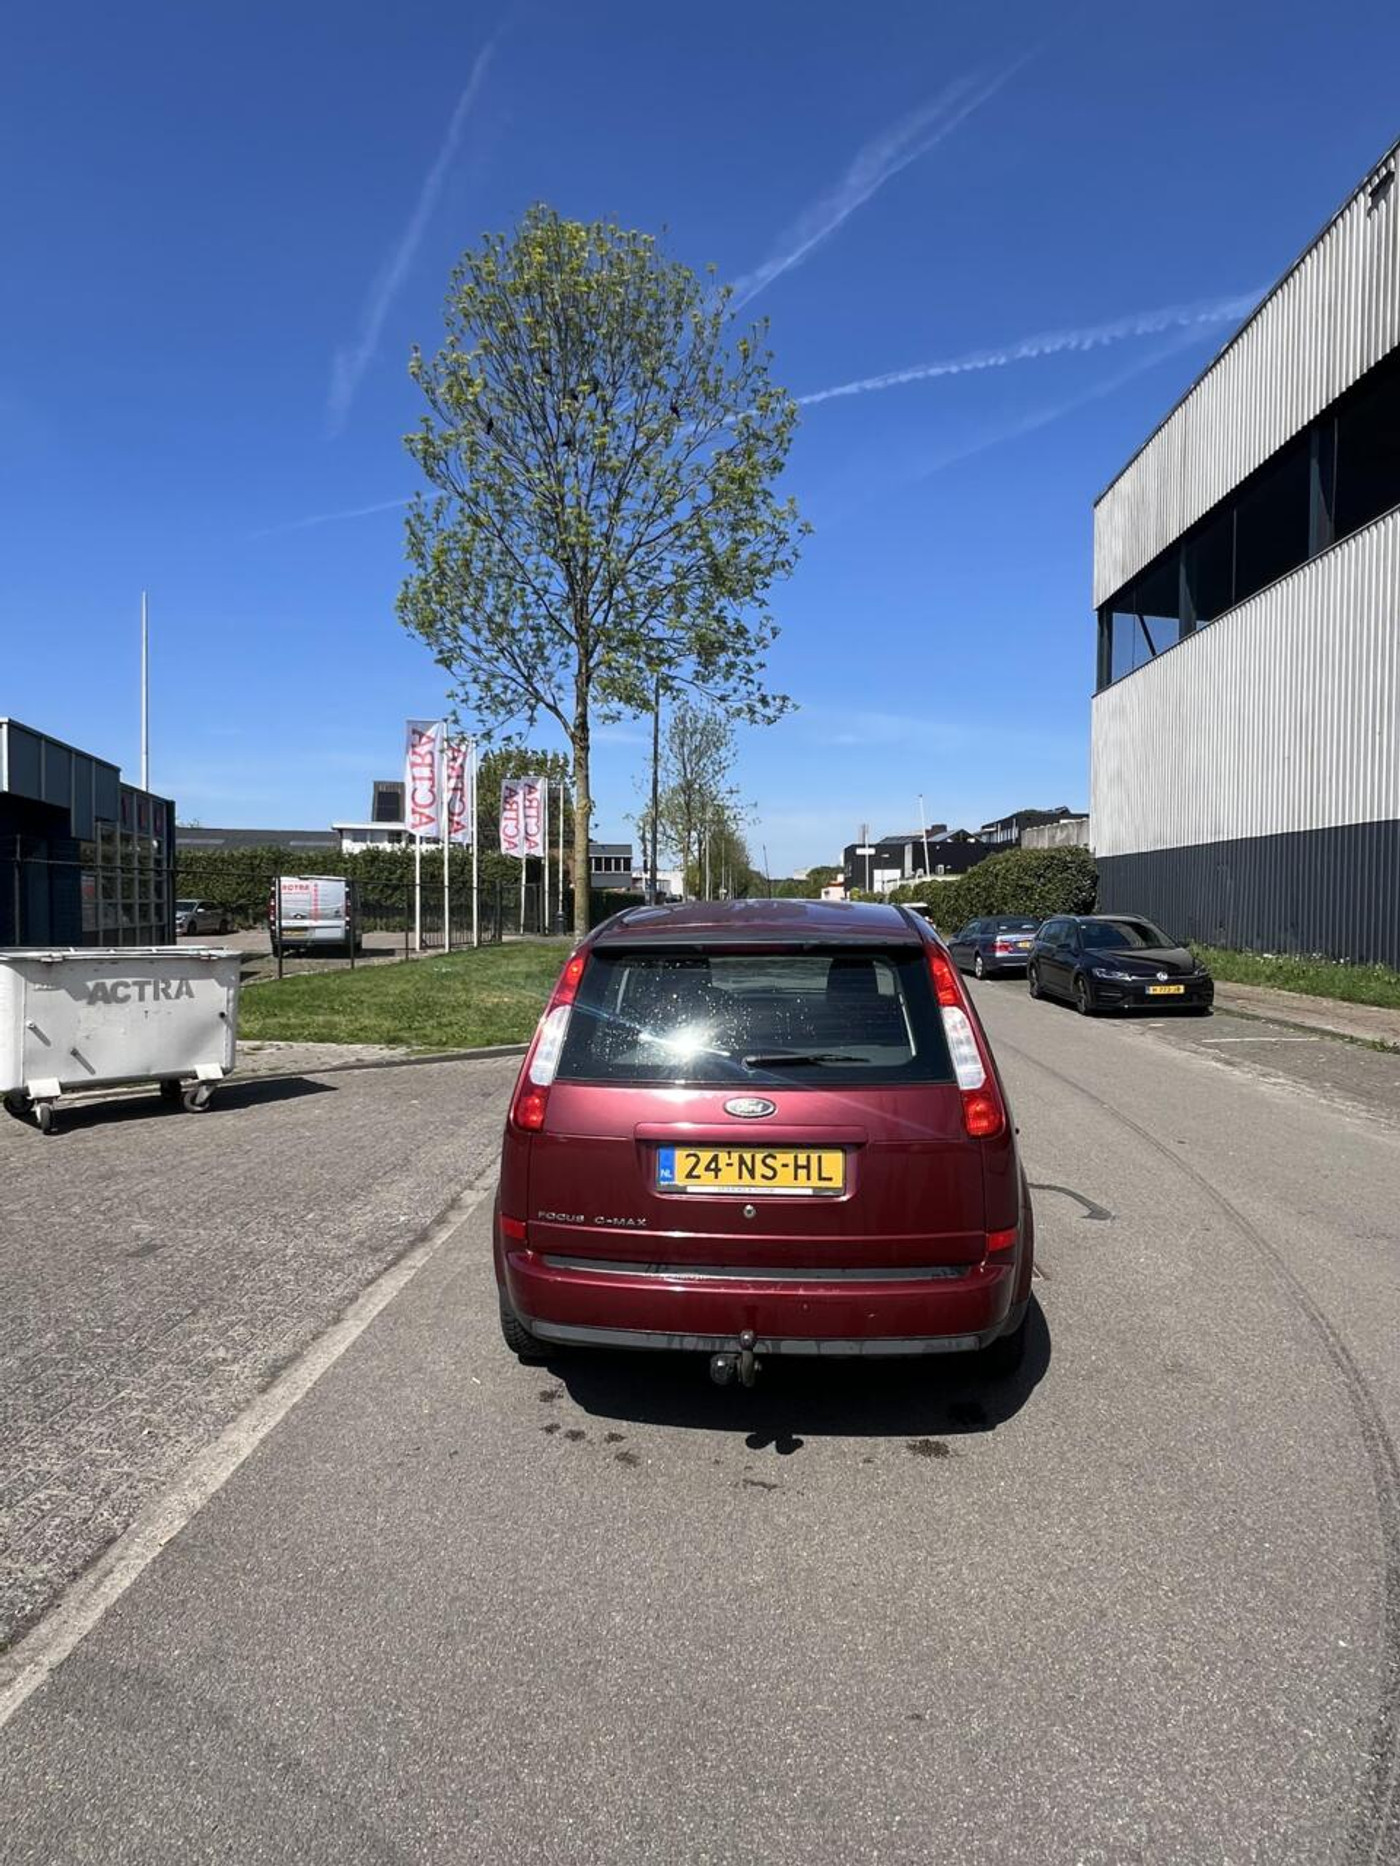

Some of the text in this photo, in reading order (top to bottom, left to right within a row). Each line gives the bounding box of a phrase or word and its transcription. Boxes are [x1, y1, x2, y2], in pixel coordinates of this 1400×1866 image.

[86, 979, 195, 1005] ACTRA
[660, 1169, 672, 1178] NL
[538, 1210, 647, 1227] FOCUS C-MAX
